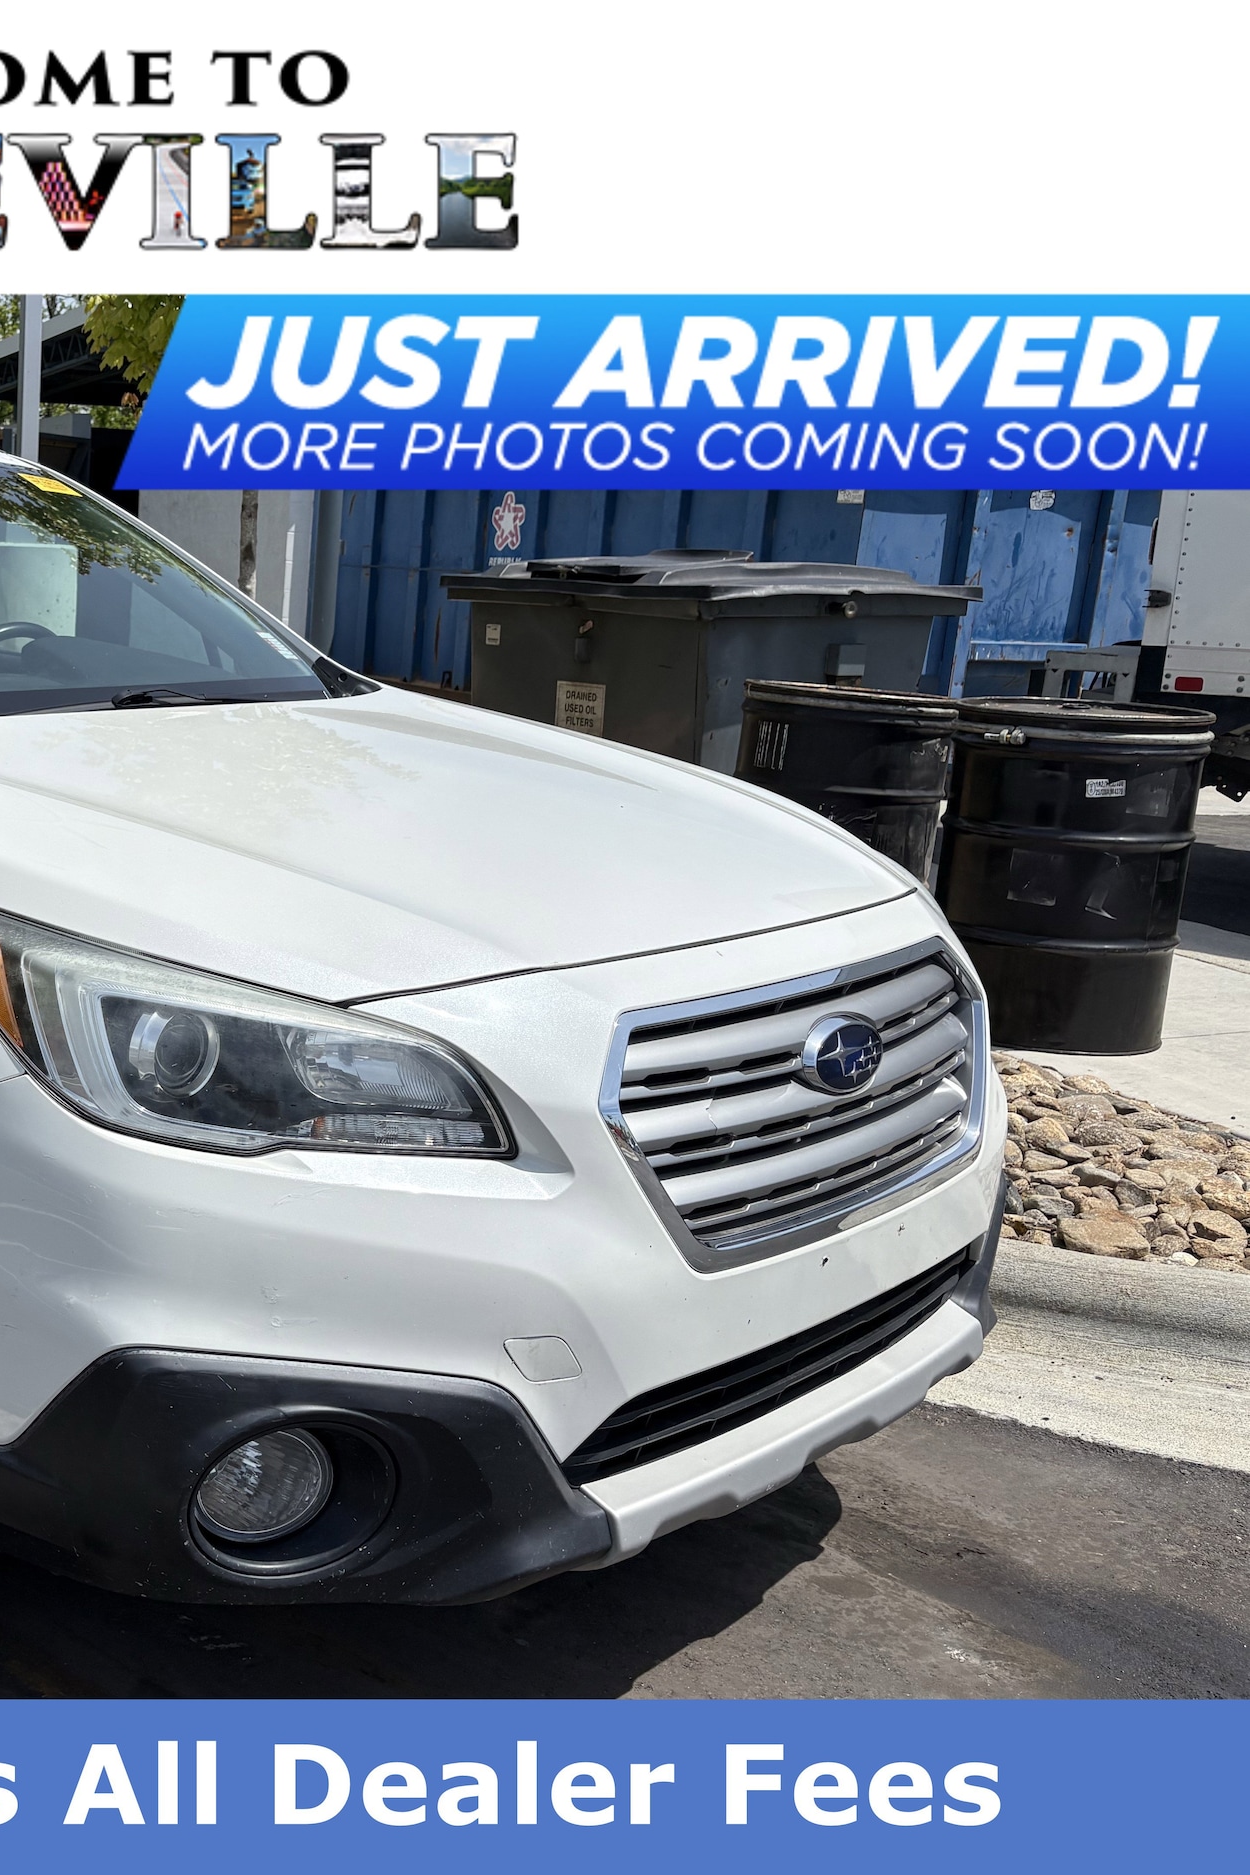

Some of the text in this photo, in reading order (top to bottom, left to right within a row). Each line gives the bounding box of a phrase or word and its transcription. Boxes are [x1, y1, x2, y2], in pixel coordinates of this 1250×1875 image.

[566, 690, 597, 702] DRAINED
[564, 703, 597, 715] USED OIL
[565, 716, 594, 728] FILTERS
